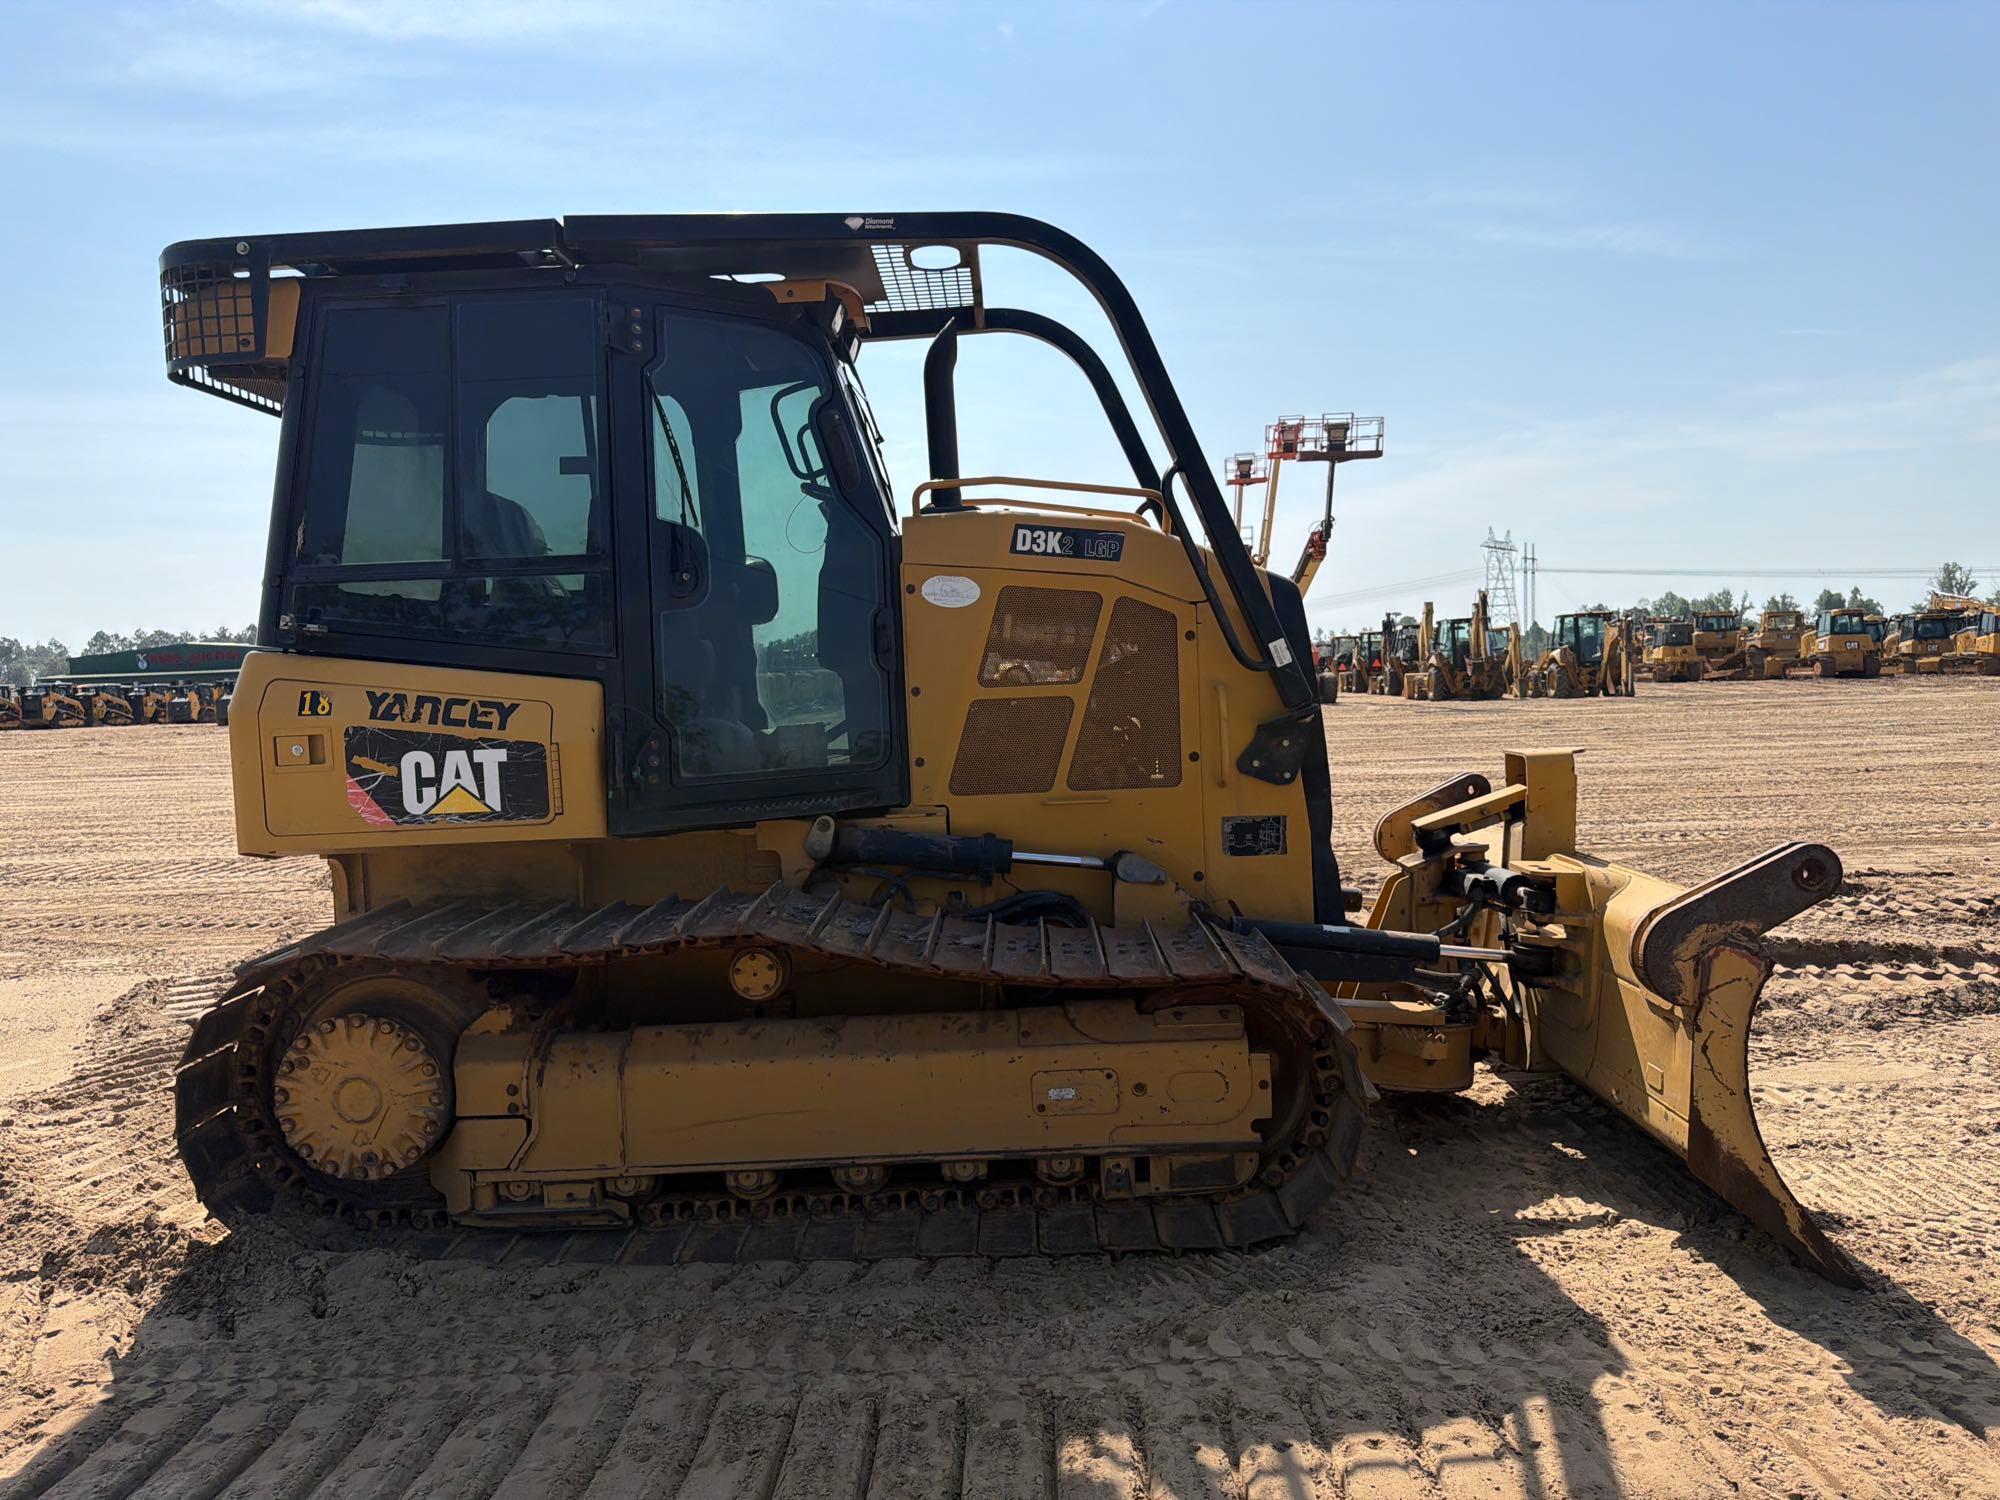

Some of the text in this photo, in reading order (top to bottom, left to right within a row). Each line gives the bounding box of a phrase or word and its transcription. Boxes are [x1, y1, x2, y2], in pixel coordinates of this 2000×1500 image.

[865, 217, 894, 225] Diamond
[1015, 528, 1120, 558] D3K2 LGP
[1846, 642, 1859, 650] CAT
[301, 692, 331, 716] 18
[365, 690, 521, 731] YANCEY
[400, 748, 508, 816] CAT
